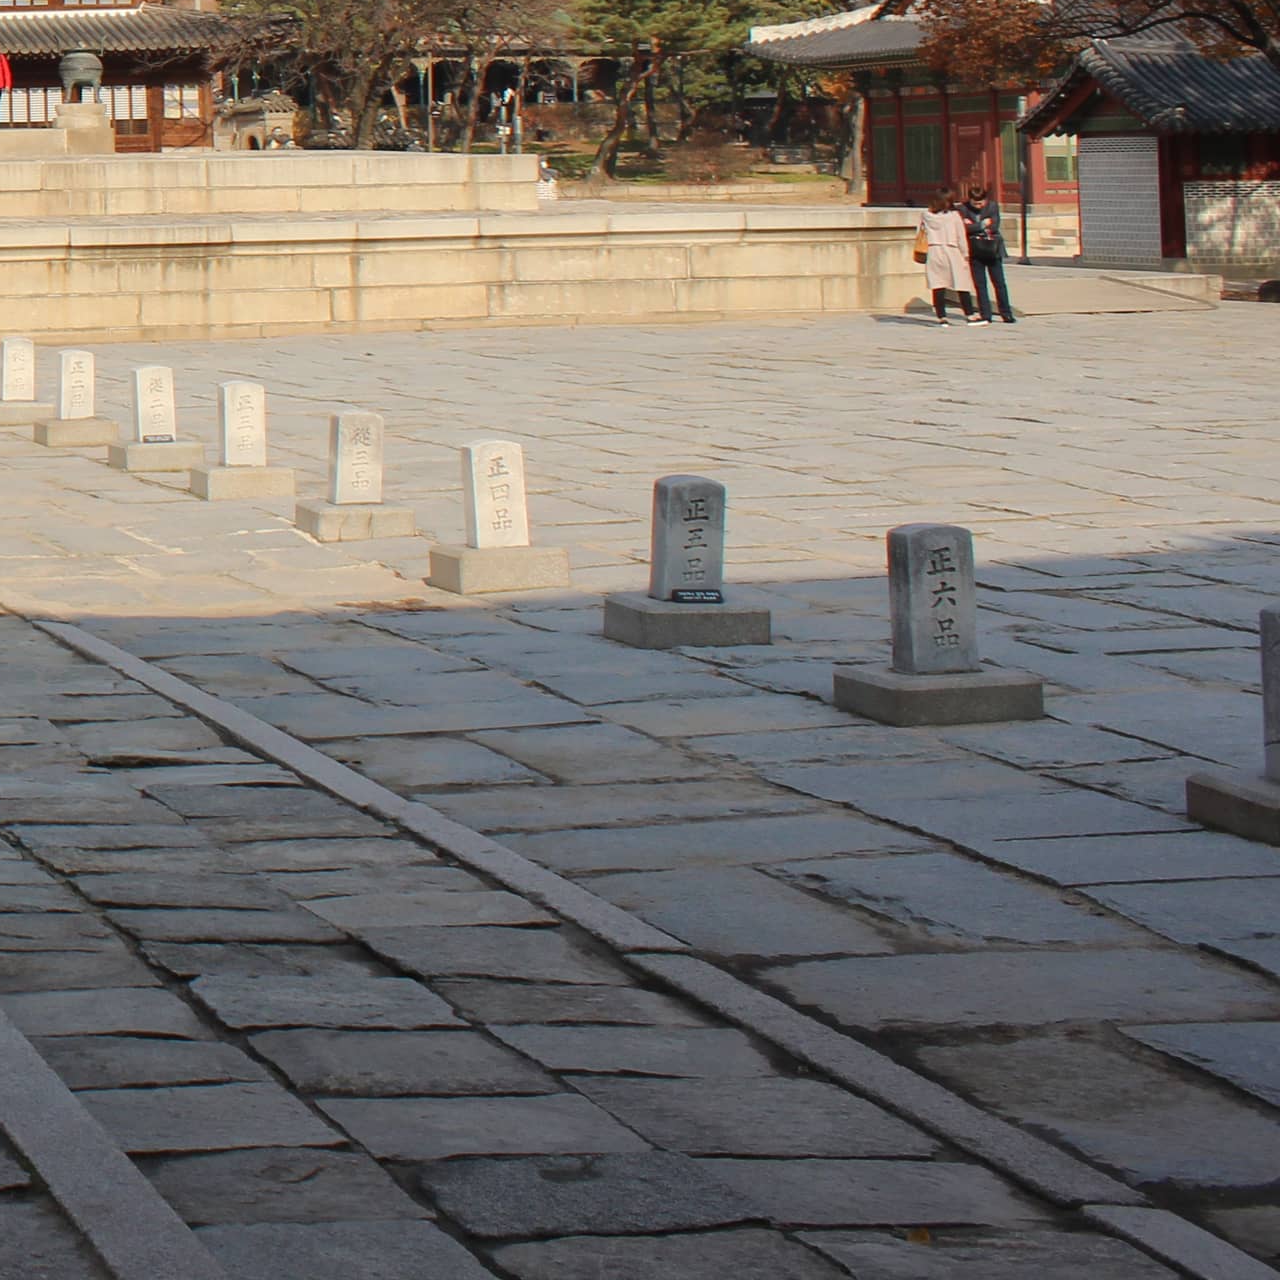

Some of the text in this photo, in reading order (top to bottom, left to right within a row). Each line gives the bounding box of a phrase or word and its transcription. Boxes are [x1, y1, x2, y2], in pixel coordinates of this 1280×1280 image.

[351, 426, 372, 489] 從三品
[487, 456, 513, 531] 正四品
[926, 545, 960, 648] 正六品
